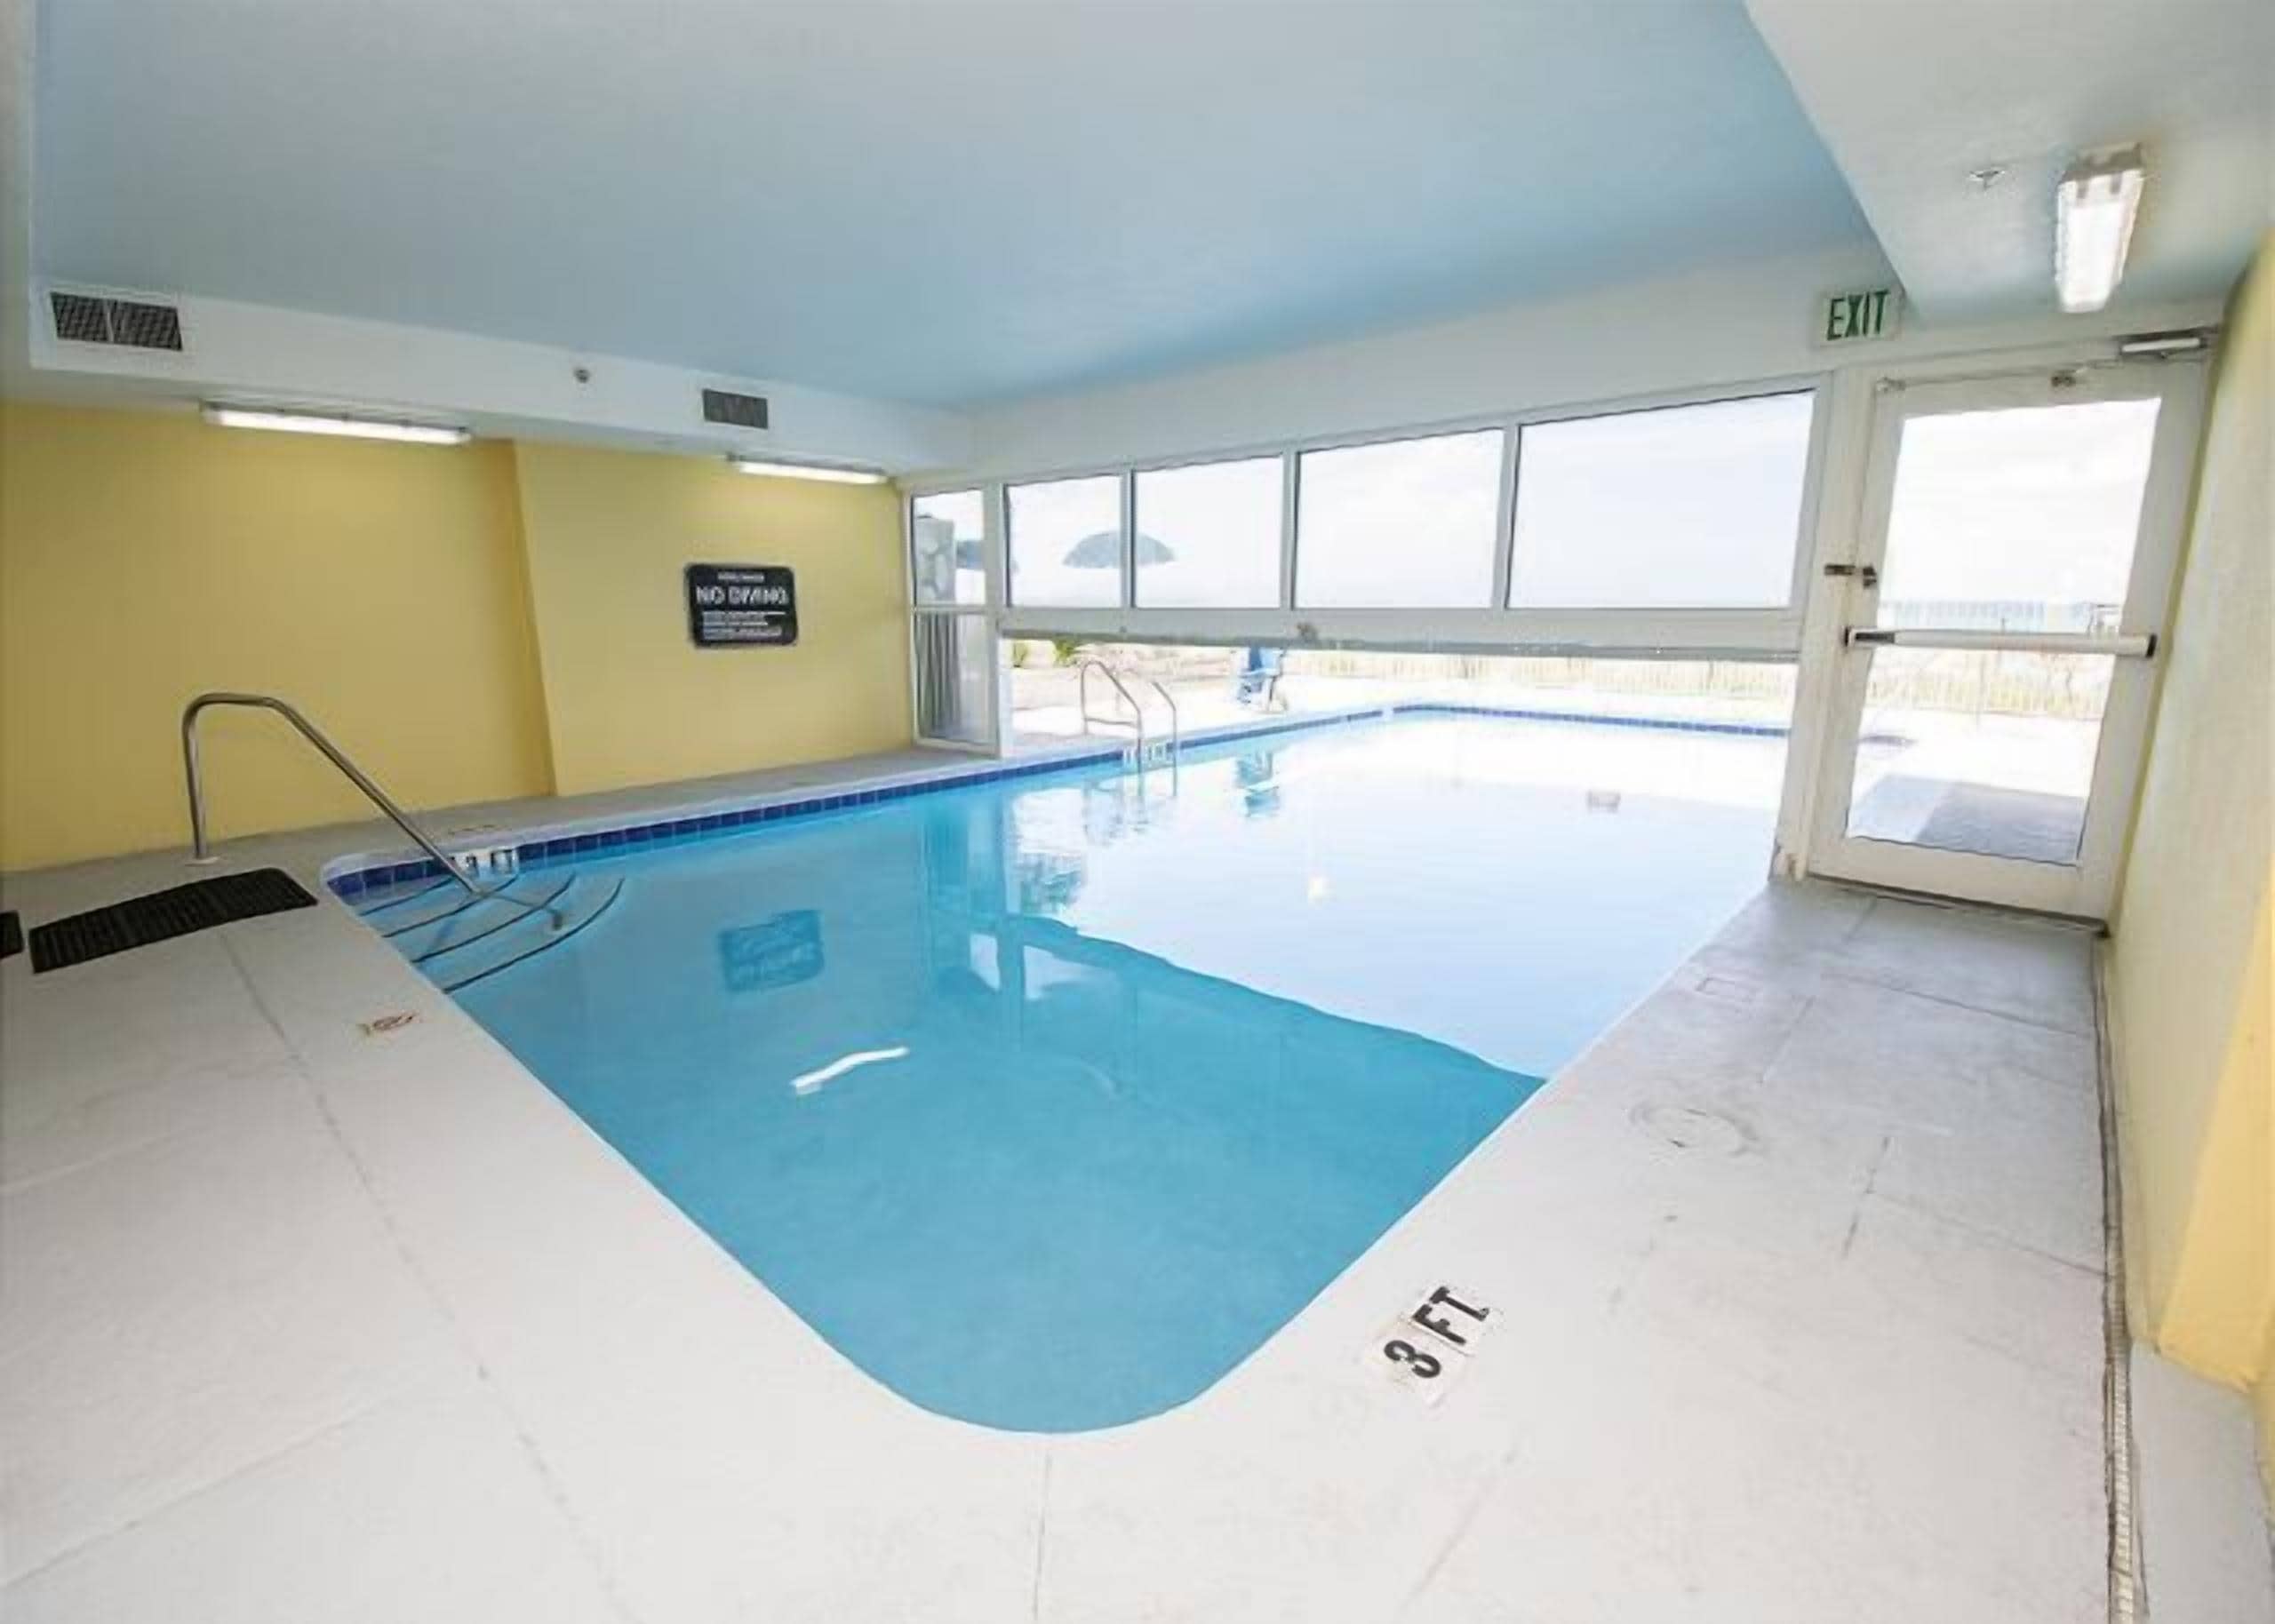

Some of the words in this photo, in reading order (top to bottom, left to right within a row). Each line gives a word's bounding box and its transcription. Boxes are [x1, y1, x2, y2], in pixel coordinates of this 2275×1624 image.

[1827, 289, 1889, 341] EXIT
[696, 585, 725, 605] NO
[1411, 1286, 1489, 1345] FT
[1384, 1340, 1441, 1379] 3
